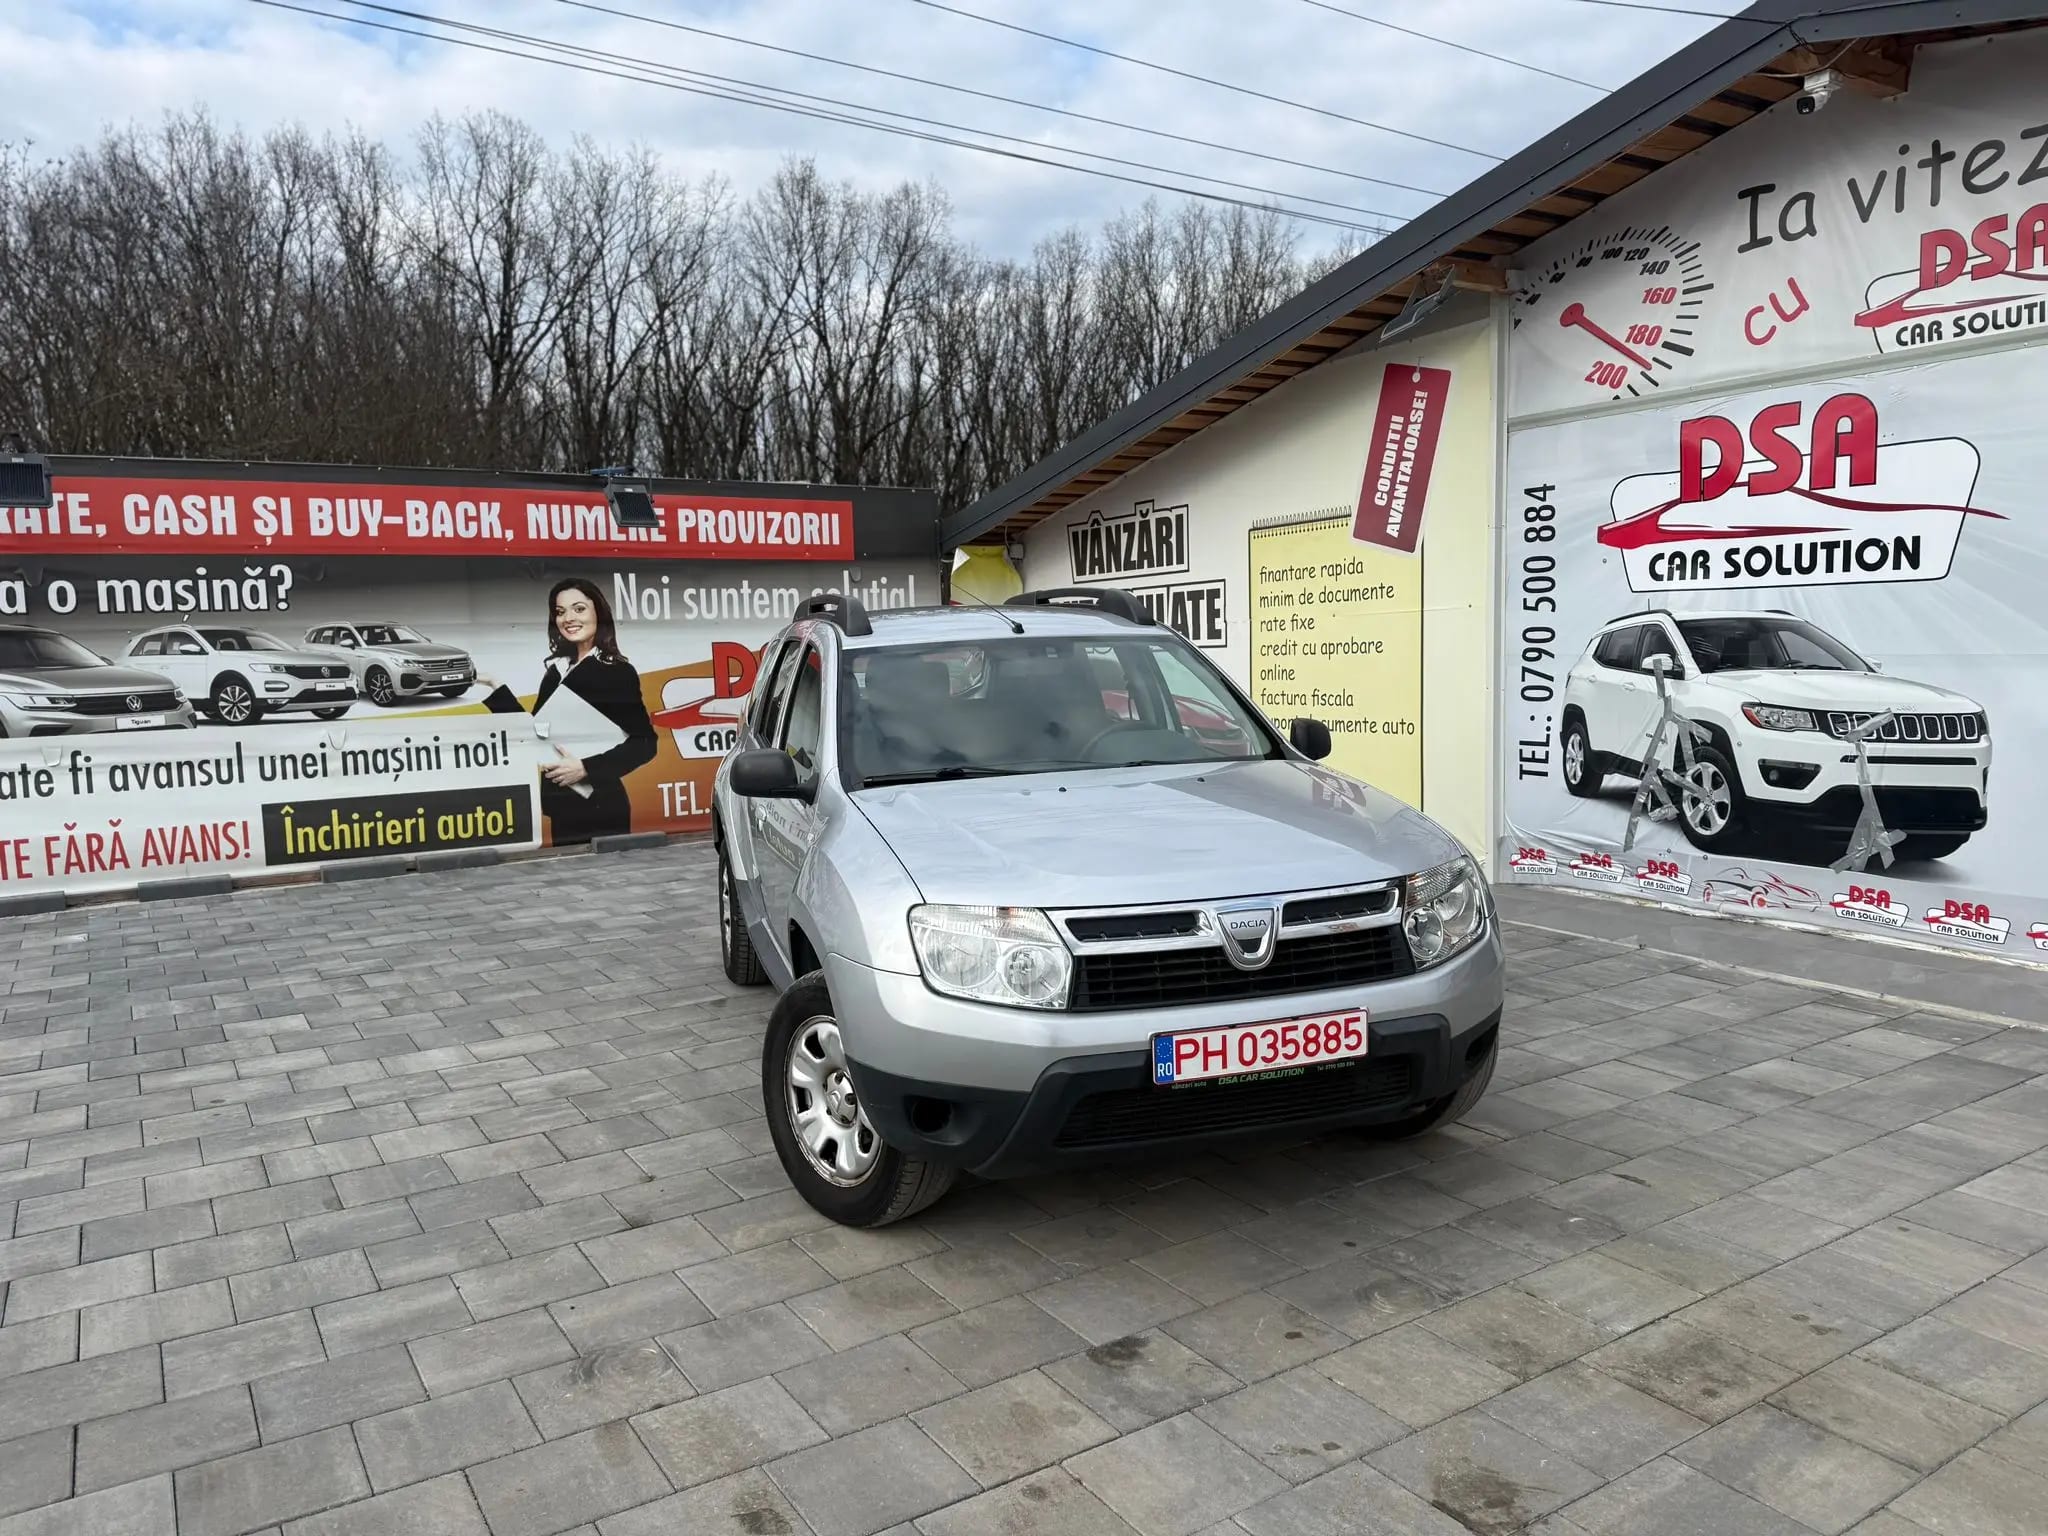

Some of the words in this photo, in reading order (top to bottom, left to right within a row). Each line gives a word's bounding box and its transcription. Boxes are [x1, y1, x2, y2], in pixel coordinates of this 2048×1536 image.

[1601, 246, 1624, 259] 100
[1624, 247, 1650, 261] 120
[1919, 203, 2048, 291] DSA
[1639, 260, 1670, 275] 140
[1642, 287, 1677, 304] 160
[1745, 277, 1810, 345] cu
[1895, 327, 1942, 347] CAR
[1953, 300, 2047, 338] SOLUTI
[1625, 324, 1663, 346] 180
[1584, 360, 1629, 389] 200
[1680, 393, 1878, 503] DSA
[1374, 415, 1404, 507] CONDITII
[1386, 390, 1428, 539] AVANTAJOASE!
[123, 493, 238, 536] CASH
[252, 496, 293, 546] ȘI
[308, 497, 514, 542] BUY-BACK,
[678, 508, 840, 546] PROVIZORII
[1524, 483, 1556, 543] 884
[1072, 508, 1185, 577] VÂNZĂRI
[1260, 565, 1316, 584] finantare
[1320, 556, 1364, 582] rapida
[1649, 550, 1710, 582] CAR
[1724, 535, 1921, 579] SOLUTION
[48, 579, 77, 614] o
[97, 563, 293, 622] mașină?
[613, 572, 670, 621] Noi
[684, 579, 800, 620] suntem
[1259, 590, 1294, 608] minim
[1298, 587, 1314, 605] de
[1318, 582, 1395, 603] documente
[1522, 555, 1556, 613] 500
[1260, 616, 1286, 632] rate
[1291, 613, 1315, 631] fixe
[1260, 639, 1298, 656] credit
[1302, 643, 1317, 656] cu
[1320, 636, 1384, 660] aprobare
[1260, 664, 1296, 681] online
[1520, 626, 1555, 702] 0790
[1260, 688, 1307, 705] factura
[1311, 688, 1354, 707] fiscala
[1382, 717, 1415, 735] auto
[0, 763, 54, 799] ate
[69, 750, 94, 794] fi
[109, 741, 244, 792] avansul
[259, 742, 328, 781] unei
[341, 736, 441, 781] mașini
[454, 730, 509, 768] noi!
[280, 805, 426, 855] Închirieri
[437, 798, 515, 841] auto!
[44, 818, 130, 876] FĂRĂ
[142, 820, 251, 868] AVANS!
[1519, 847, 1546, 860] DSA
[1580, 853, 1612, 868] DSA
[1647, 860, 1679, 878] DSA
[1589, 871, 1618, 881] SOLUTION
[1643, 880, 1655, 888] CAR
[1656, 882, 1685, 893] SOLUTION
[1849, 885, 1891, 909] DSA
[1230, 919, 1267, 929] DACIA
[1841, 909, 1856, 918] CAR
[1858, 911, 1898, 925] SOLUTION
[1944, 899, 1990, 924] DSA
[1936, 924, 1953, 934] CAR
[1955, 927, 1999, 942] SOLUTION
[1175, 1035, 1228, 1075] PH
[1238, 1017, 1363, 1067] 035885
[1158, 1062, 1172, 1077] RO
[1218, 1077, 1238, 1085] DSA
[1240, 1073, 1258, 1082] CAR
[1259, 1067, 1305, 1080] SOLUTION
